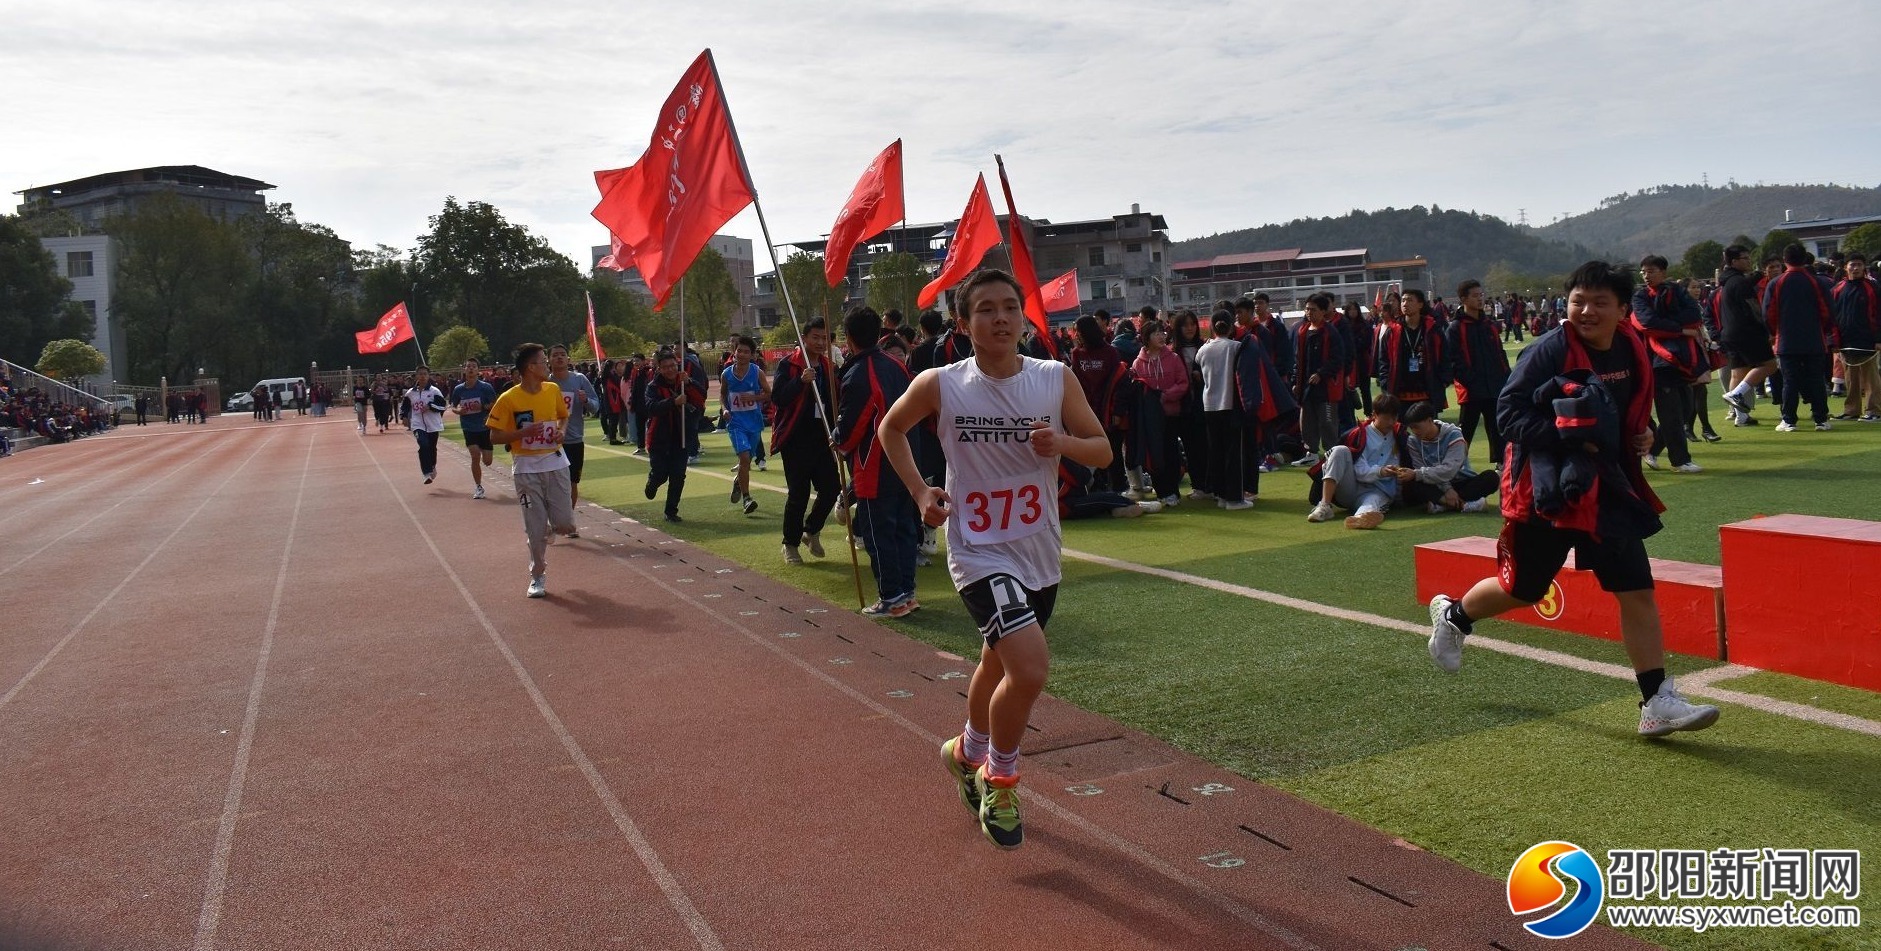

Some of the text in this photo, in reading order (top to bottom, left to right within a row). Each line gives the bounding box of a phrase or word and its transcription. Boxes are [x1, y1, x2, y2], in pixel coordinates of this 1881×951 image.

[955, 415, 1004, 426] BRING
[958, 429, 1030, 444] ATTITU
[965, 484, 1042, 533] 373
[1538, 583, 1557, 616] 3
